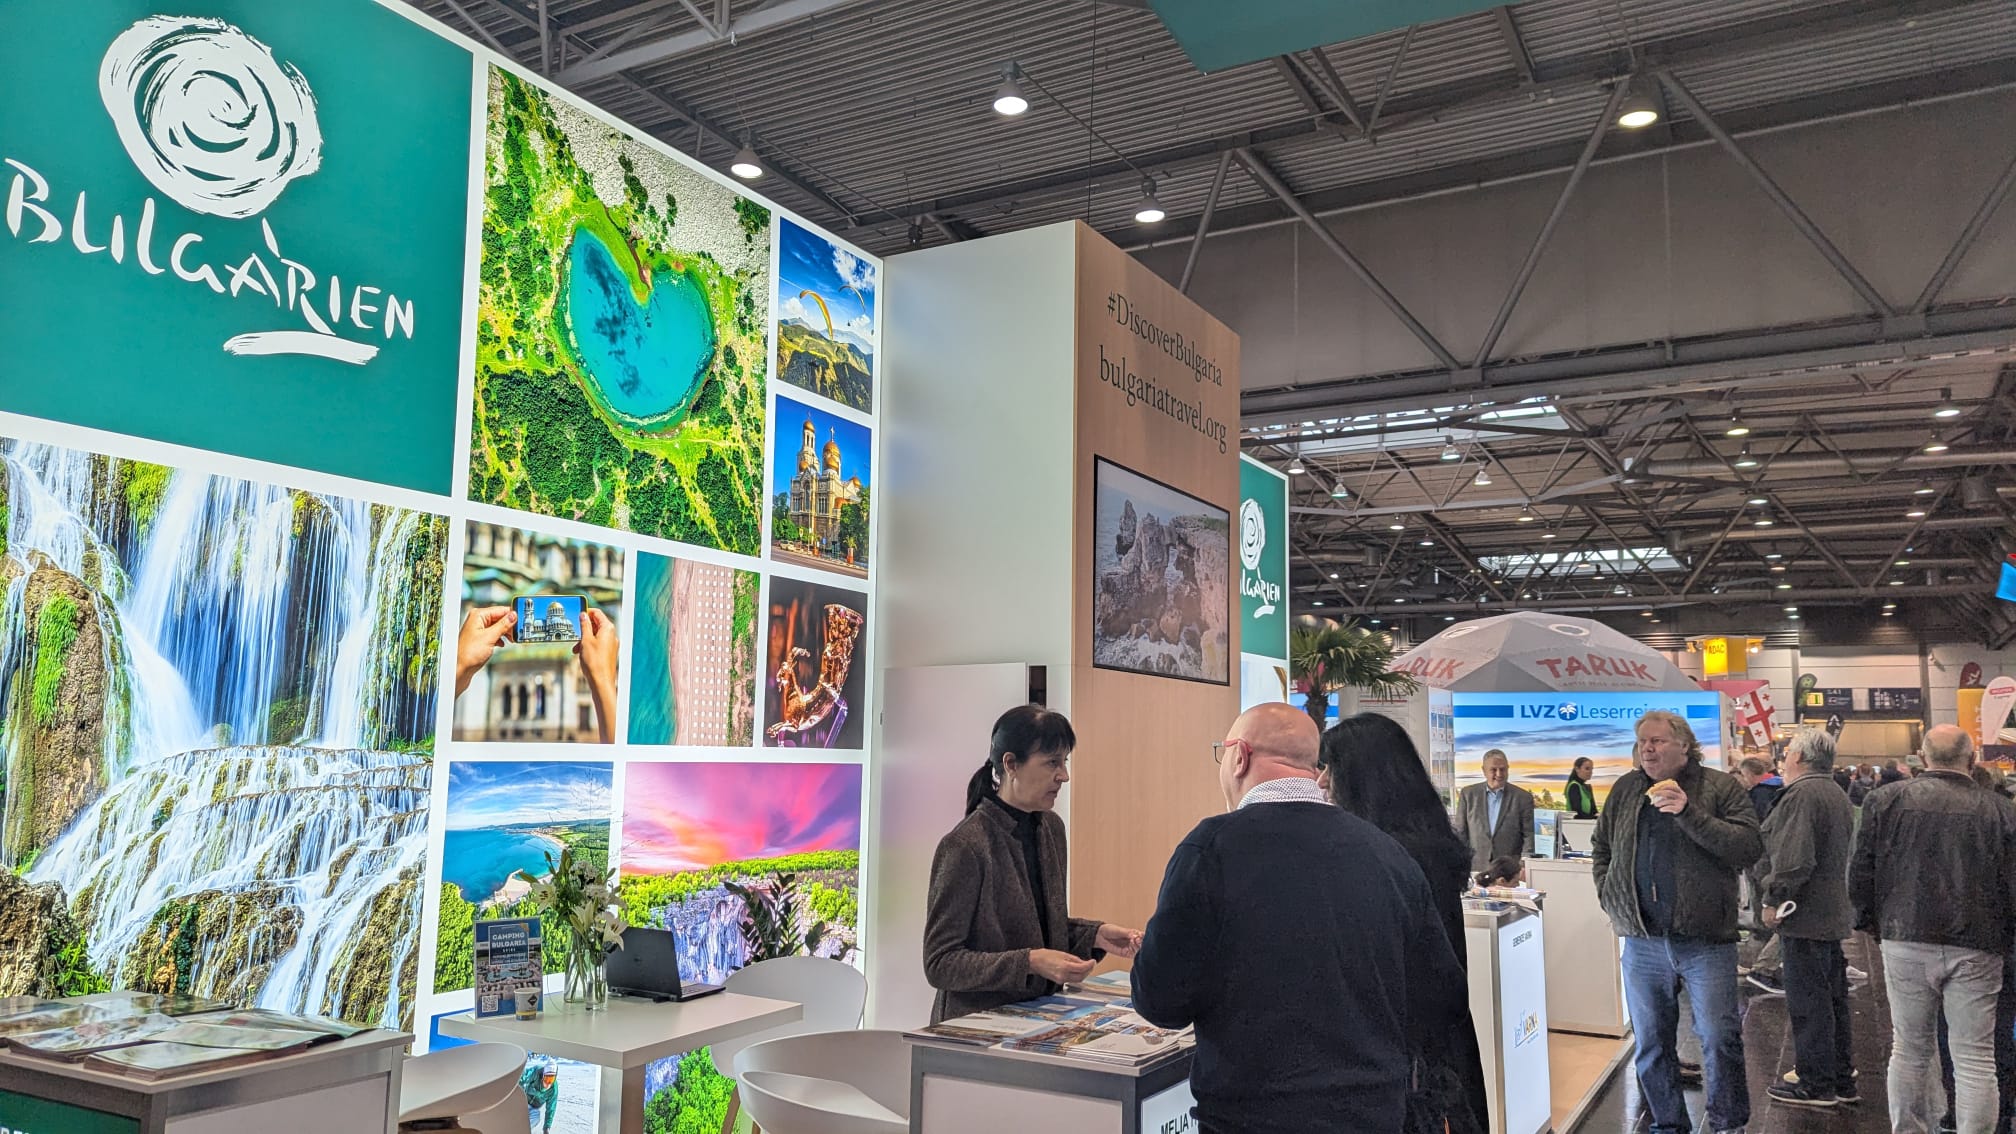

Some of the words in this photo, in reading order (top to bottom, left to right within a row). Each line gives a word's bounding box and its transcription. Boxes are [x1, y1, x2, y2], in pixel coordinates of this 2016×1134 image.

[5, 158, 415, 339] BULGARIEN
[1107, 291, 1222, 387] #DiscoverBulgaria
[1098, 344, 1227, 454] bulgariatravel.org
[1240, 567, 1281, 605] LGARIEN
[1391, 656, 1464, 680] RUK
[1535, 653, 1657, 682] TARUK
[1521, 704, 1556, 719] LVZ
[1580, 703, 1680, 719] Leserren
[491, 939, 527, 949] BULGARIA
[492, 931, 525, 941] CAMPING
